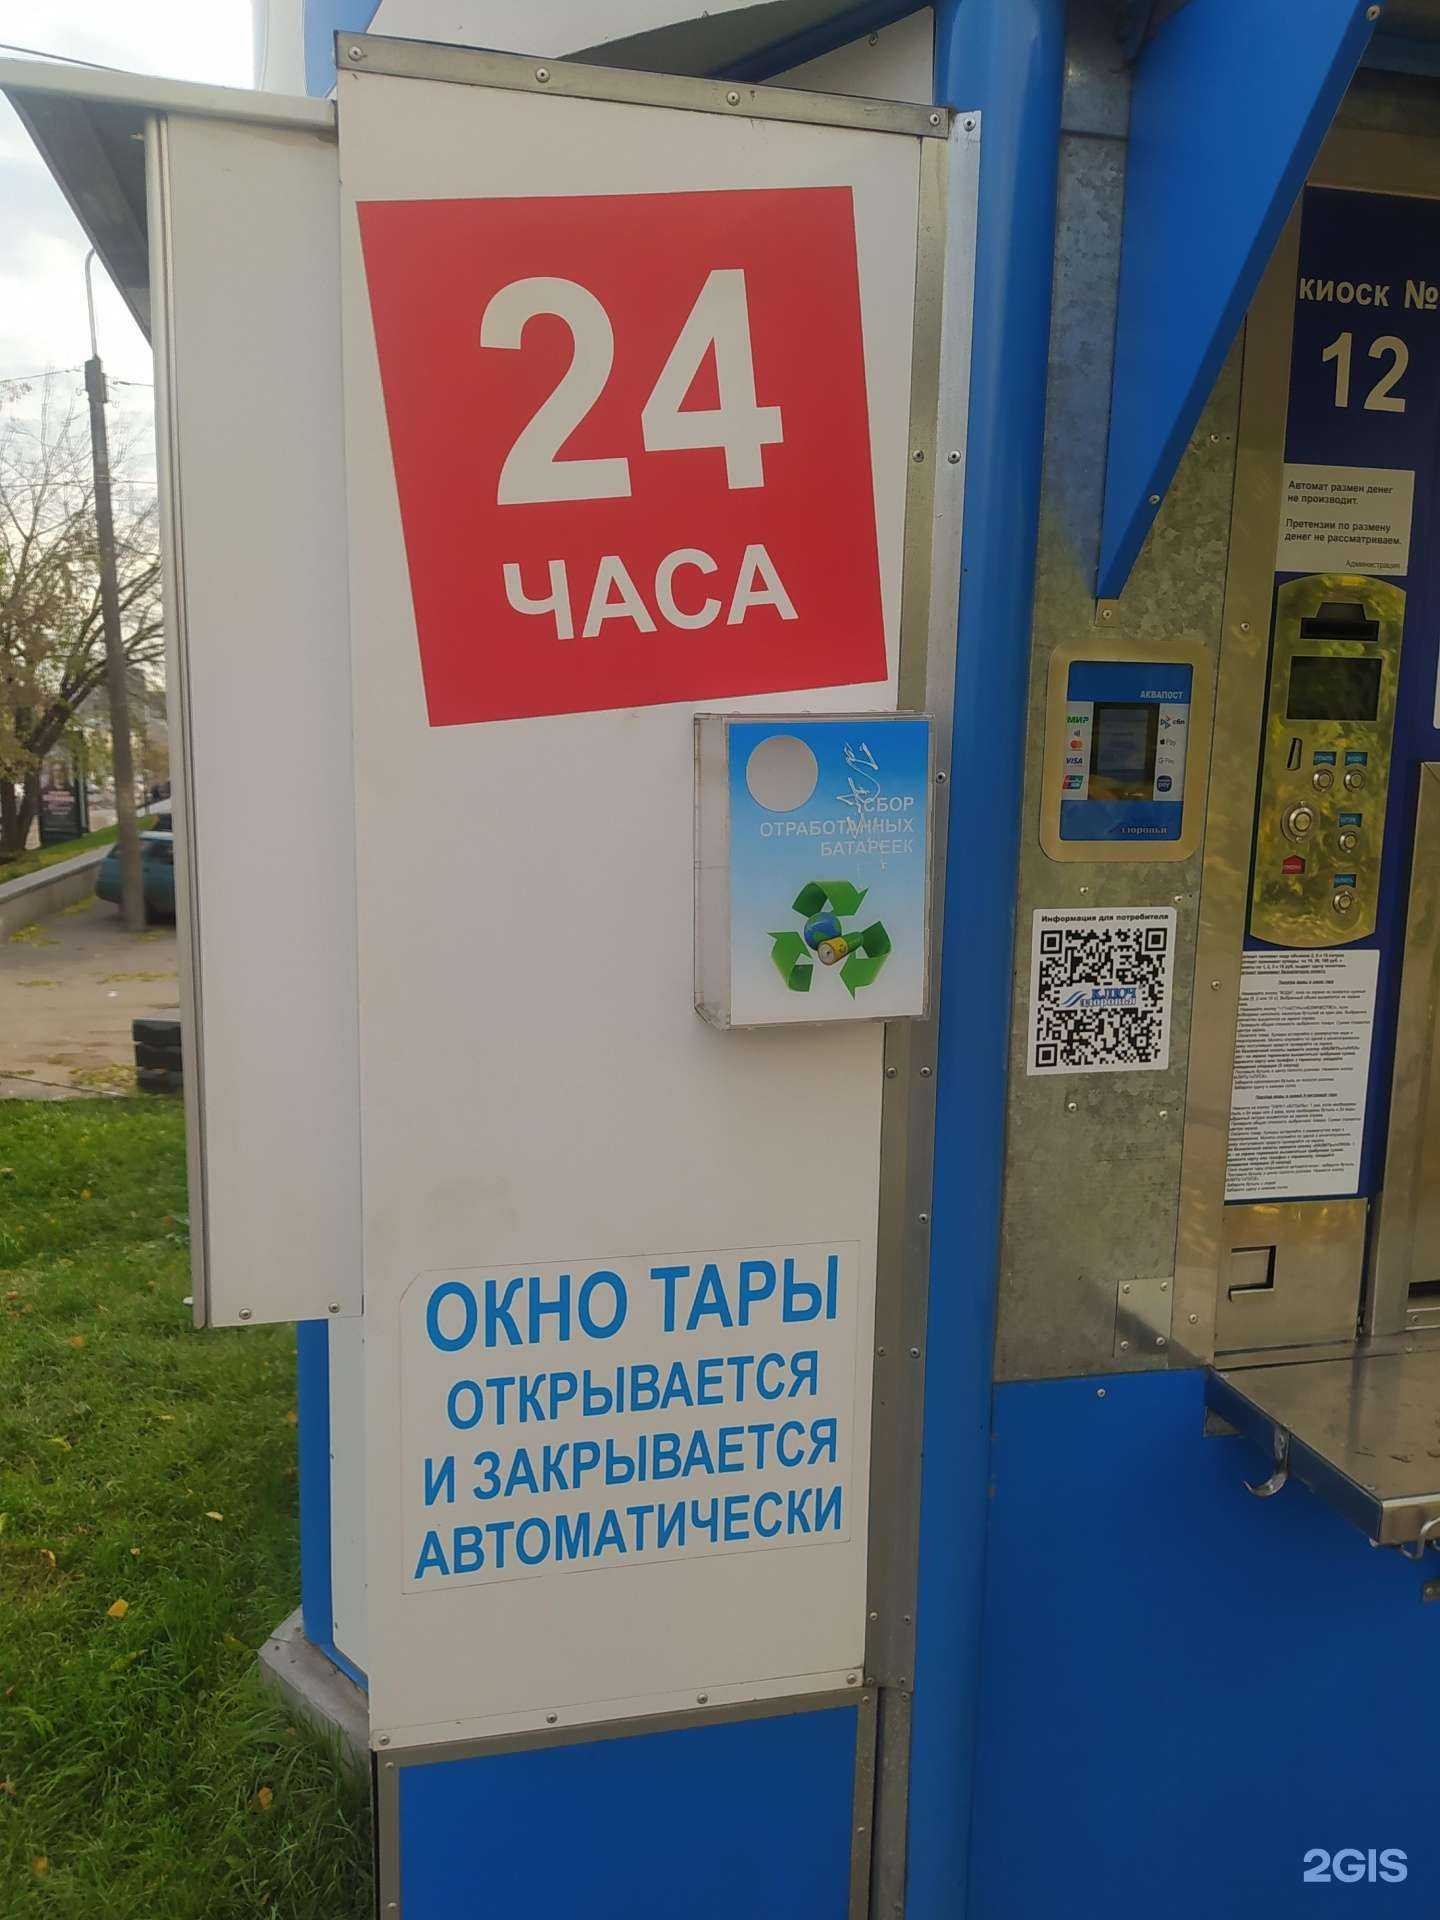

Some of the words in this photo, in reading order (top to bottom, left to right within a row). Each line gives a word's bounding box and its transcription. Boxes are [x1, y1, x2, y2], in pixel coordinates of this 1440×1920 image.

[1404, 279, 1439, 310] №
[1322, 332, 1409, 413] 12
[480, 268, 784, 505] 24
[1288, 480, 1328, 491] Автомат
[1330, 483, 1365, 494] размен
[1367, 485, 1394, 494] денег
[1287, 494, 1299, 503] не
[1301, 495, 1359, 505] производит.
[1286, 518, 1336, 530] Претензии
[1338, 521, 1350, 530] по
[1352, 522, 1391, 533] размену
[1285, 532, 1312, 541] денег
[1314, 533, 1325, 541] не
[1327, 534, 1402, 545] рассматриваем.
[502, 543, 799, 640] ЧАСА
[1140, 690, 1184, 699] АКВАПОСТ
[1067, 716, 1090, 724] МИР
[1066, 757, 1083, 765] VISA
[862, 796, 914, 812] СБОР
[760, 817, 914, 838] ОТРАБОТАННЫХ
[820, 839, 914, 857] БАТАРЕЕК
[1041, 914, 1097, 923] Информация
[1116, 913, 1169, 921] потребителя
[426, 1270, 628, 1352] ОКНО
[650, 1255, 839, 1332] ТАРЫ
[446, 1350, 819, 1430] ОТКРЫВАЕТСЯ
[424, 1456, 455, 1506] И
[472, 1418, 838, 1501] ЗАКРЫВАЕТСЯ
[414, 1486, 842, 1579] АВТОМАТИЧЕСКИ
